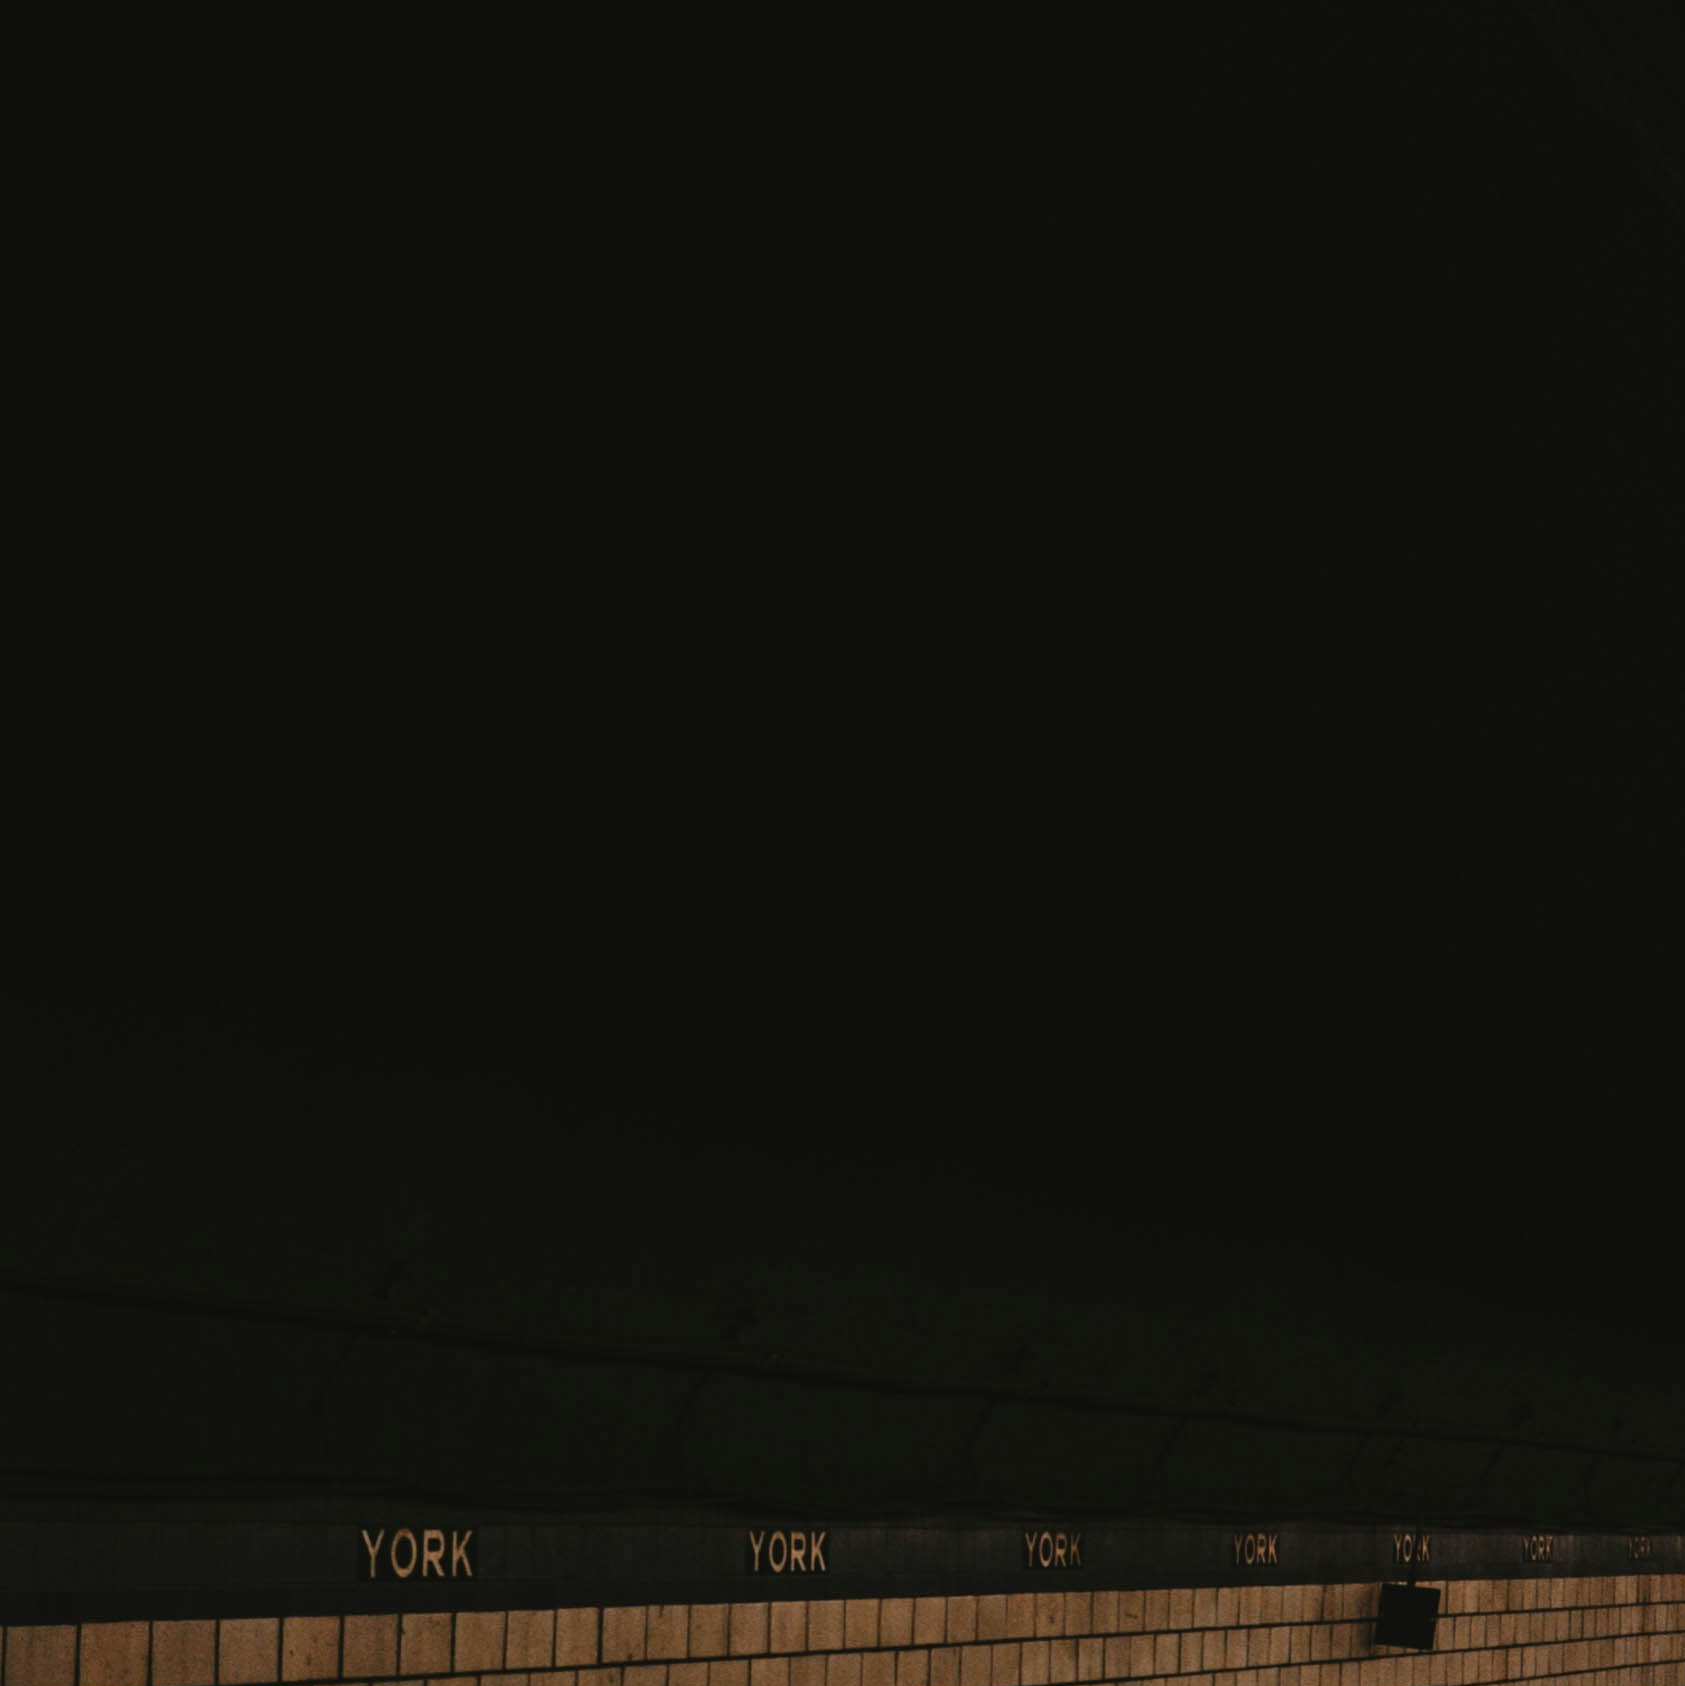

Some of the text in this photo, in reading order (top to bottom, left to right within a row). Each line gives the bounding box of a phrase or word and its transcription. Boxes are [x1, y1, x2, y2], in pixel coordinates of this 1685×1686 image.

[361, 1528, 473, 1579] YORK
[748, 1529, 827, 1573] YORK
[1024, 1531, 1082, 1569] YORK
[1234, 1533, 1279, 1567] YORK
[1523, 1535, 1553, 1562] YORK
